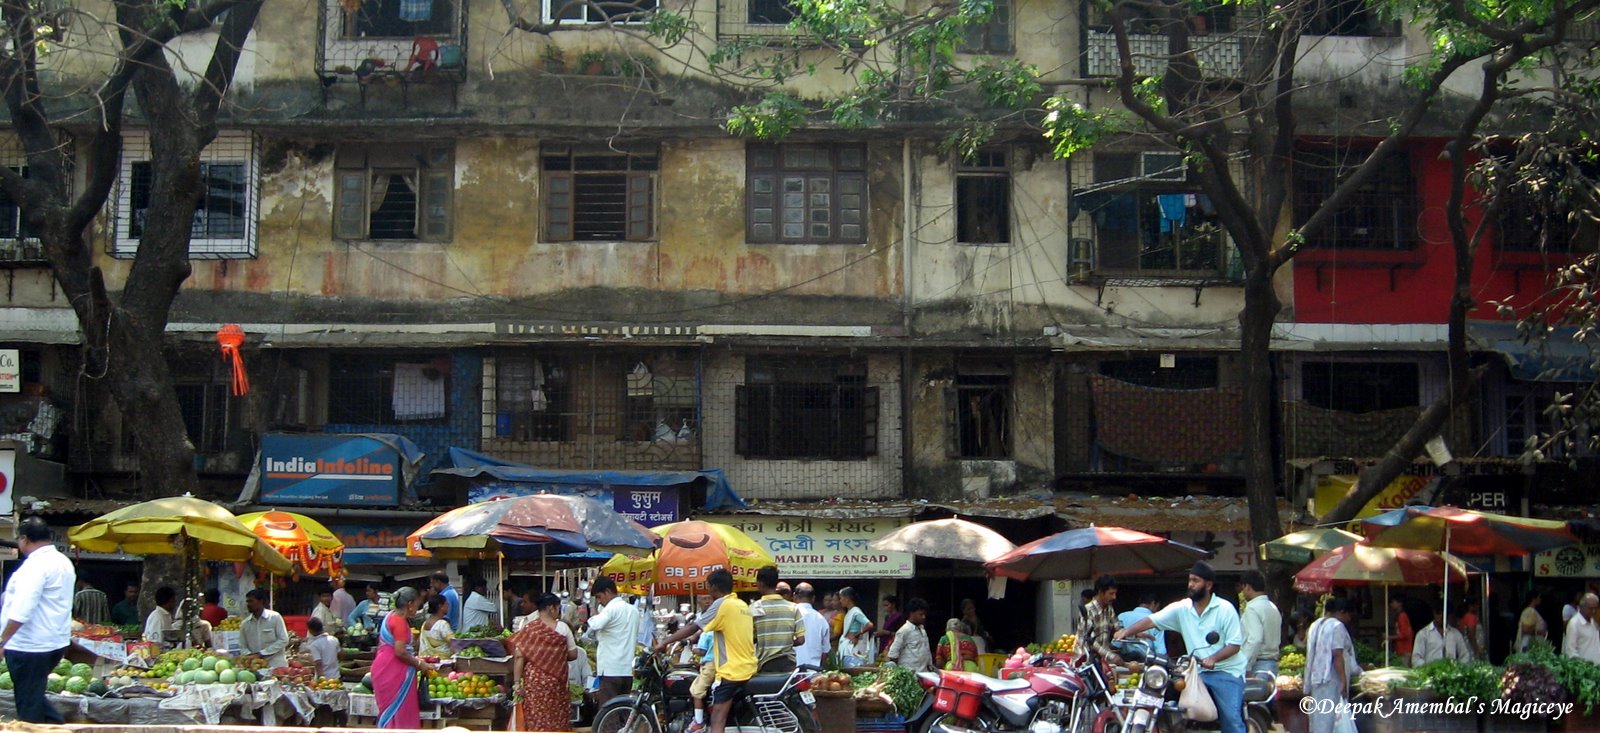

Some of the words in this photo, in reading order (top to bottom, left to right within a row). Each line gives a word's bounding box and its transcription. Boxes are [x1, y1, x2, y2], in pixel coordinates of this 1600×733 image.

[630, 491, 661, 509] कुसुम
[1467, 492, 1505, 506] PER
[775, 555, 824, 563] MAITRI
[832, 555, 888, 563] SANSAD
